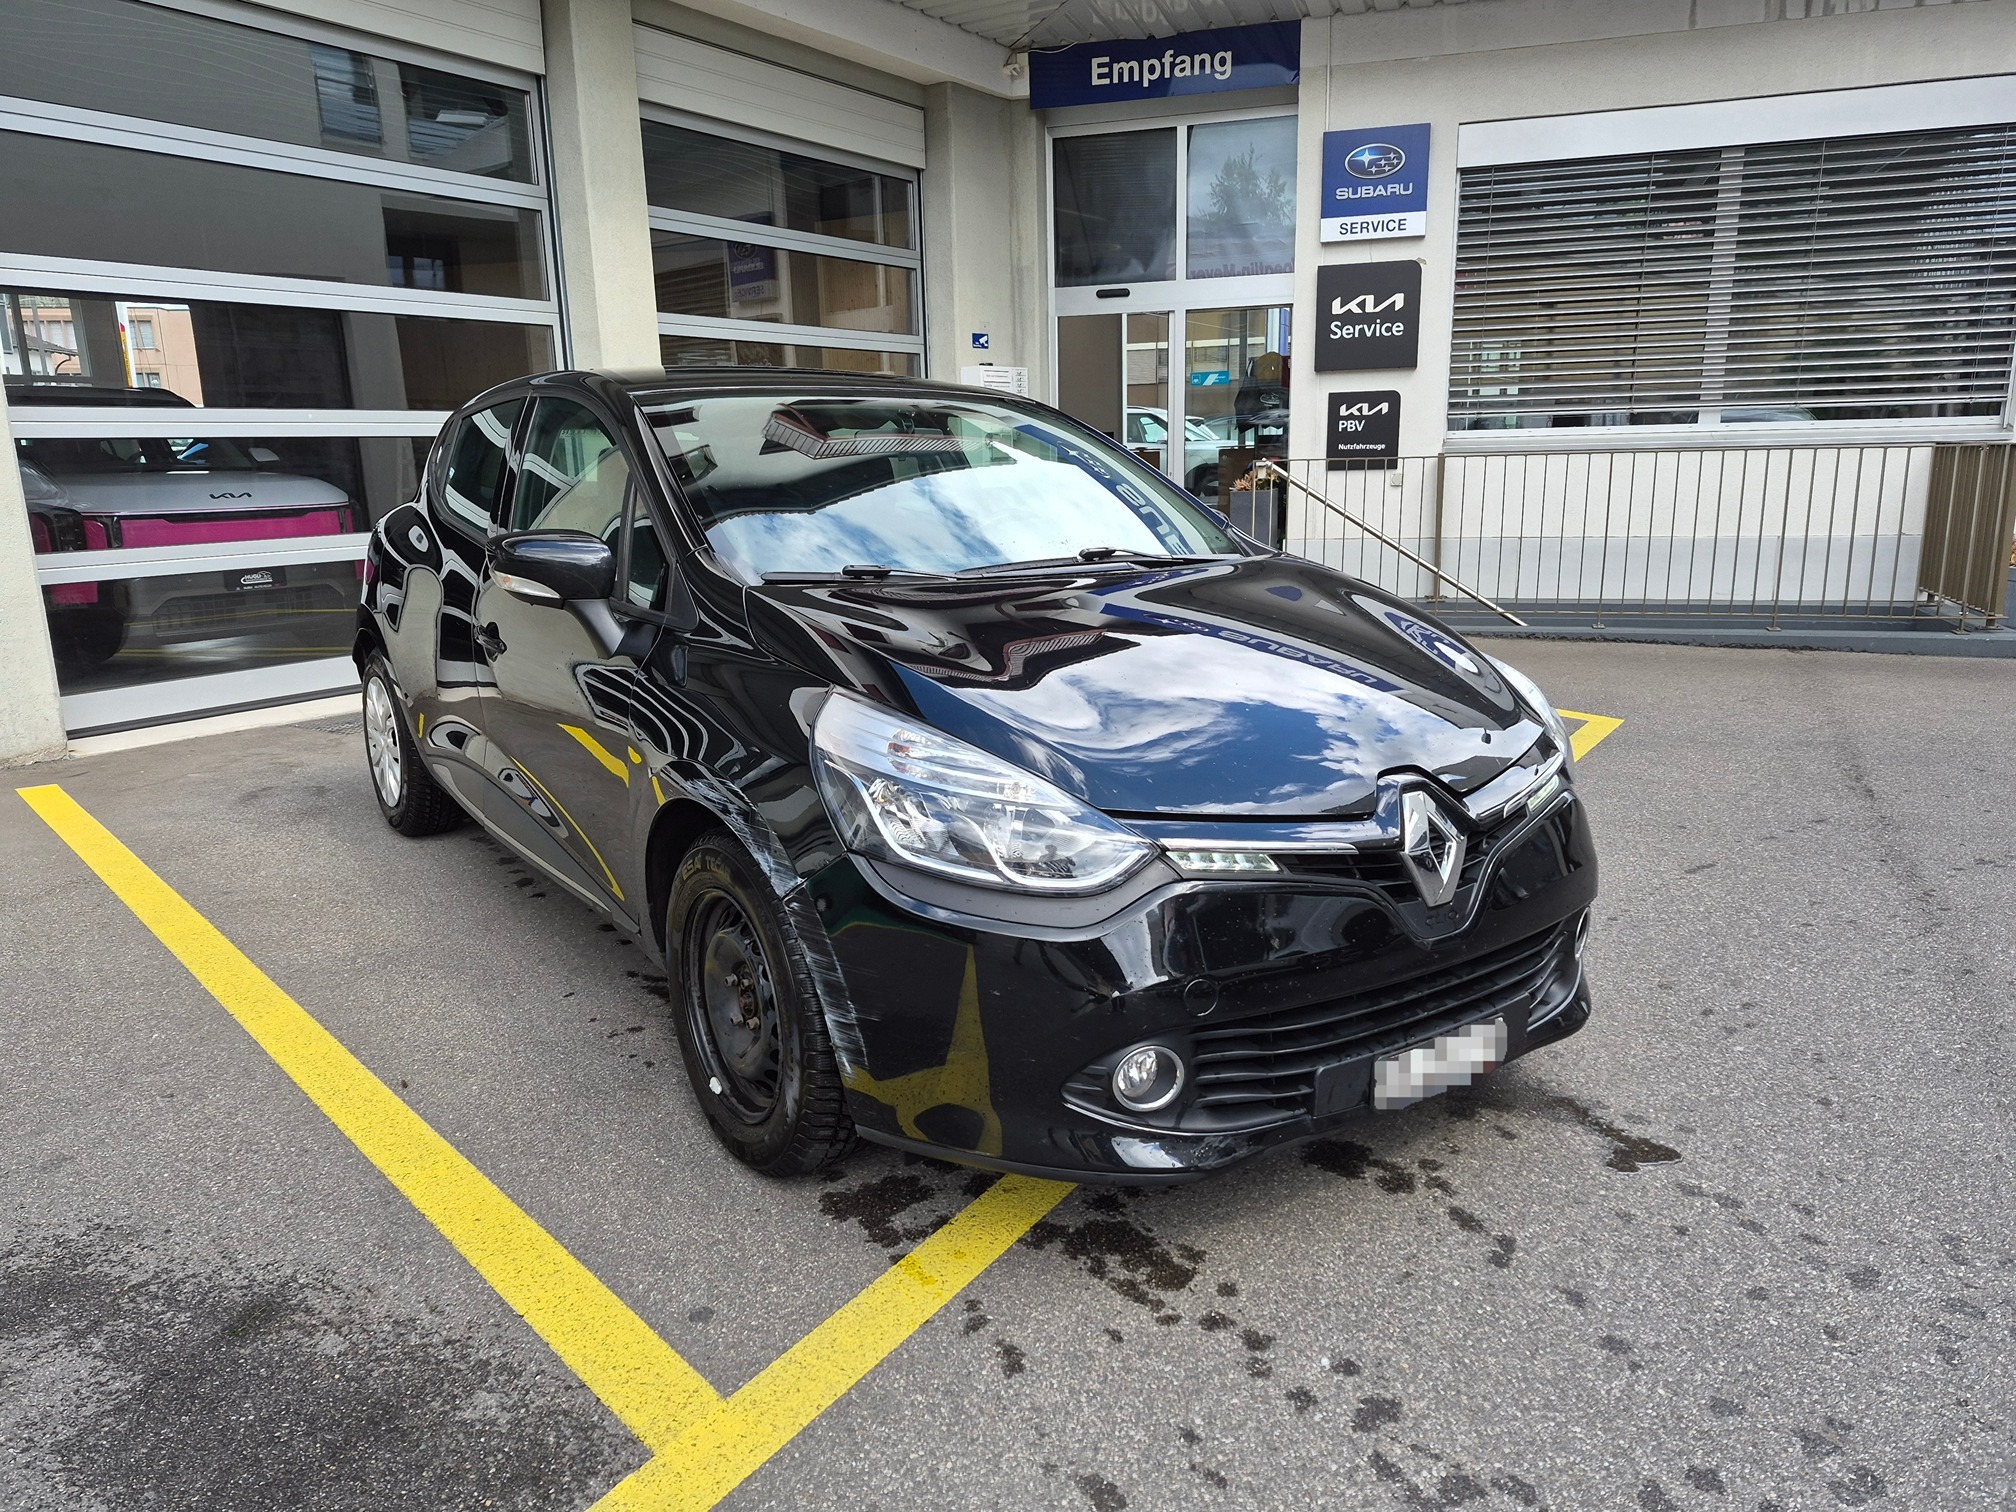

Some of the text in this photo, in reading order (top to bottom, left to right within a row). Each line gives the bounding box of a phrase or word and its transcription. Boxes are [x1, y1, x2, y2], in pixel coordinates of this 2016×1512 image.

[1091, 49, 1233, 88] Empfang
[1335, 181, 1413, 200] SUBARU
[1339, 218, 1408, 236] SERVICE
[1331, 292, 1405, 315] KIA
[1329, 318, 1404, 340] Service
[1339, 402, 1389, 416] KIA
[1338, 420, 1365, 432] PBV
[1338, 443, 1386, 451] Nutzfahrzeuge
